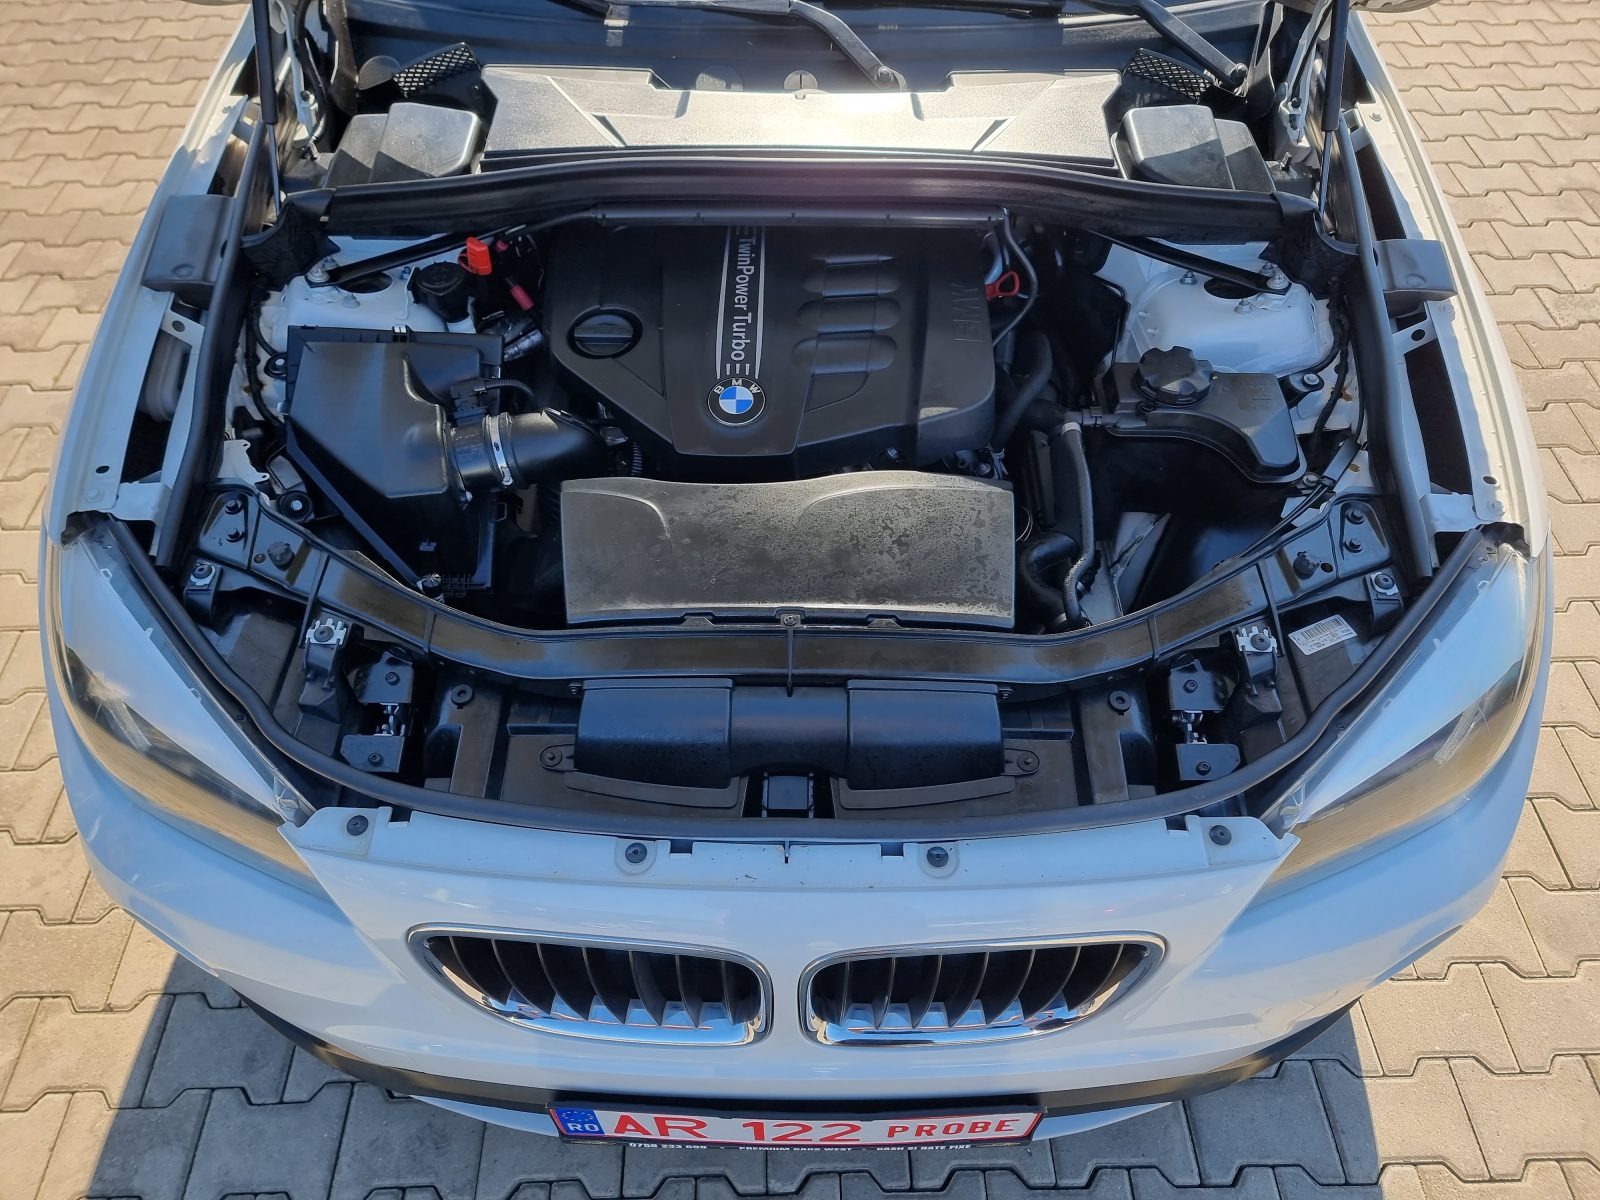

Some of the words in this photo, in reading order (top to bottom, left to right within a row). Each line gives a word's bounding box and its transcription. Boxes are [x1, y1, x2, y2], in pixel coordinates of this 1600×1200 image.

[734, 237, 756, 309] TwinPower
[731, 311, 752, 361] Turbo
[713, 378, 761, 395] BMW
[568, 1122, 600, 1133] RO
[613, 1114, 710, 1139] AR
[742, 1121, 862, 1142] 122
[887, 1118, 1020, 1139] PROBE
